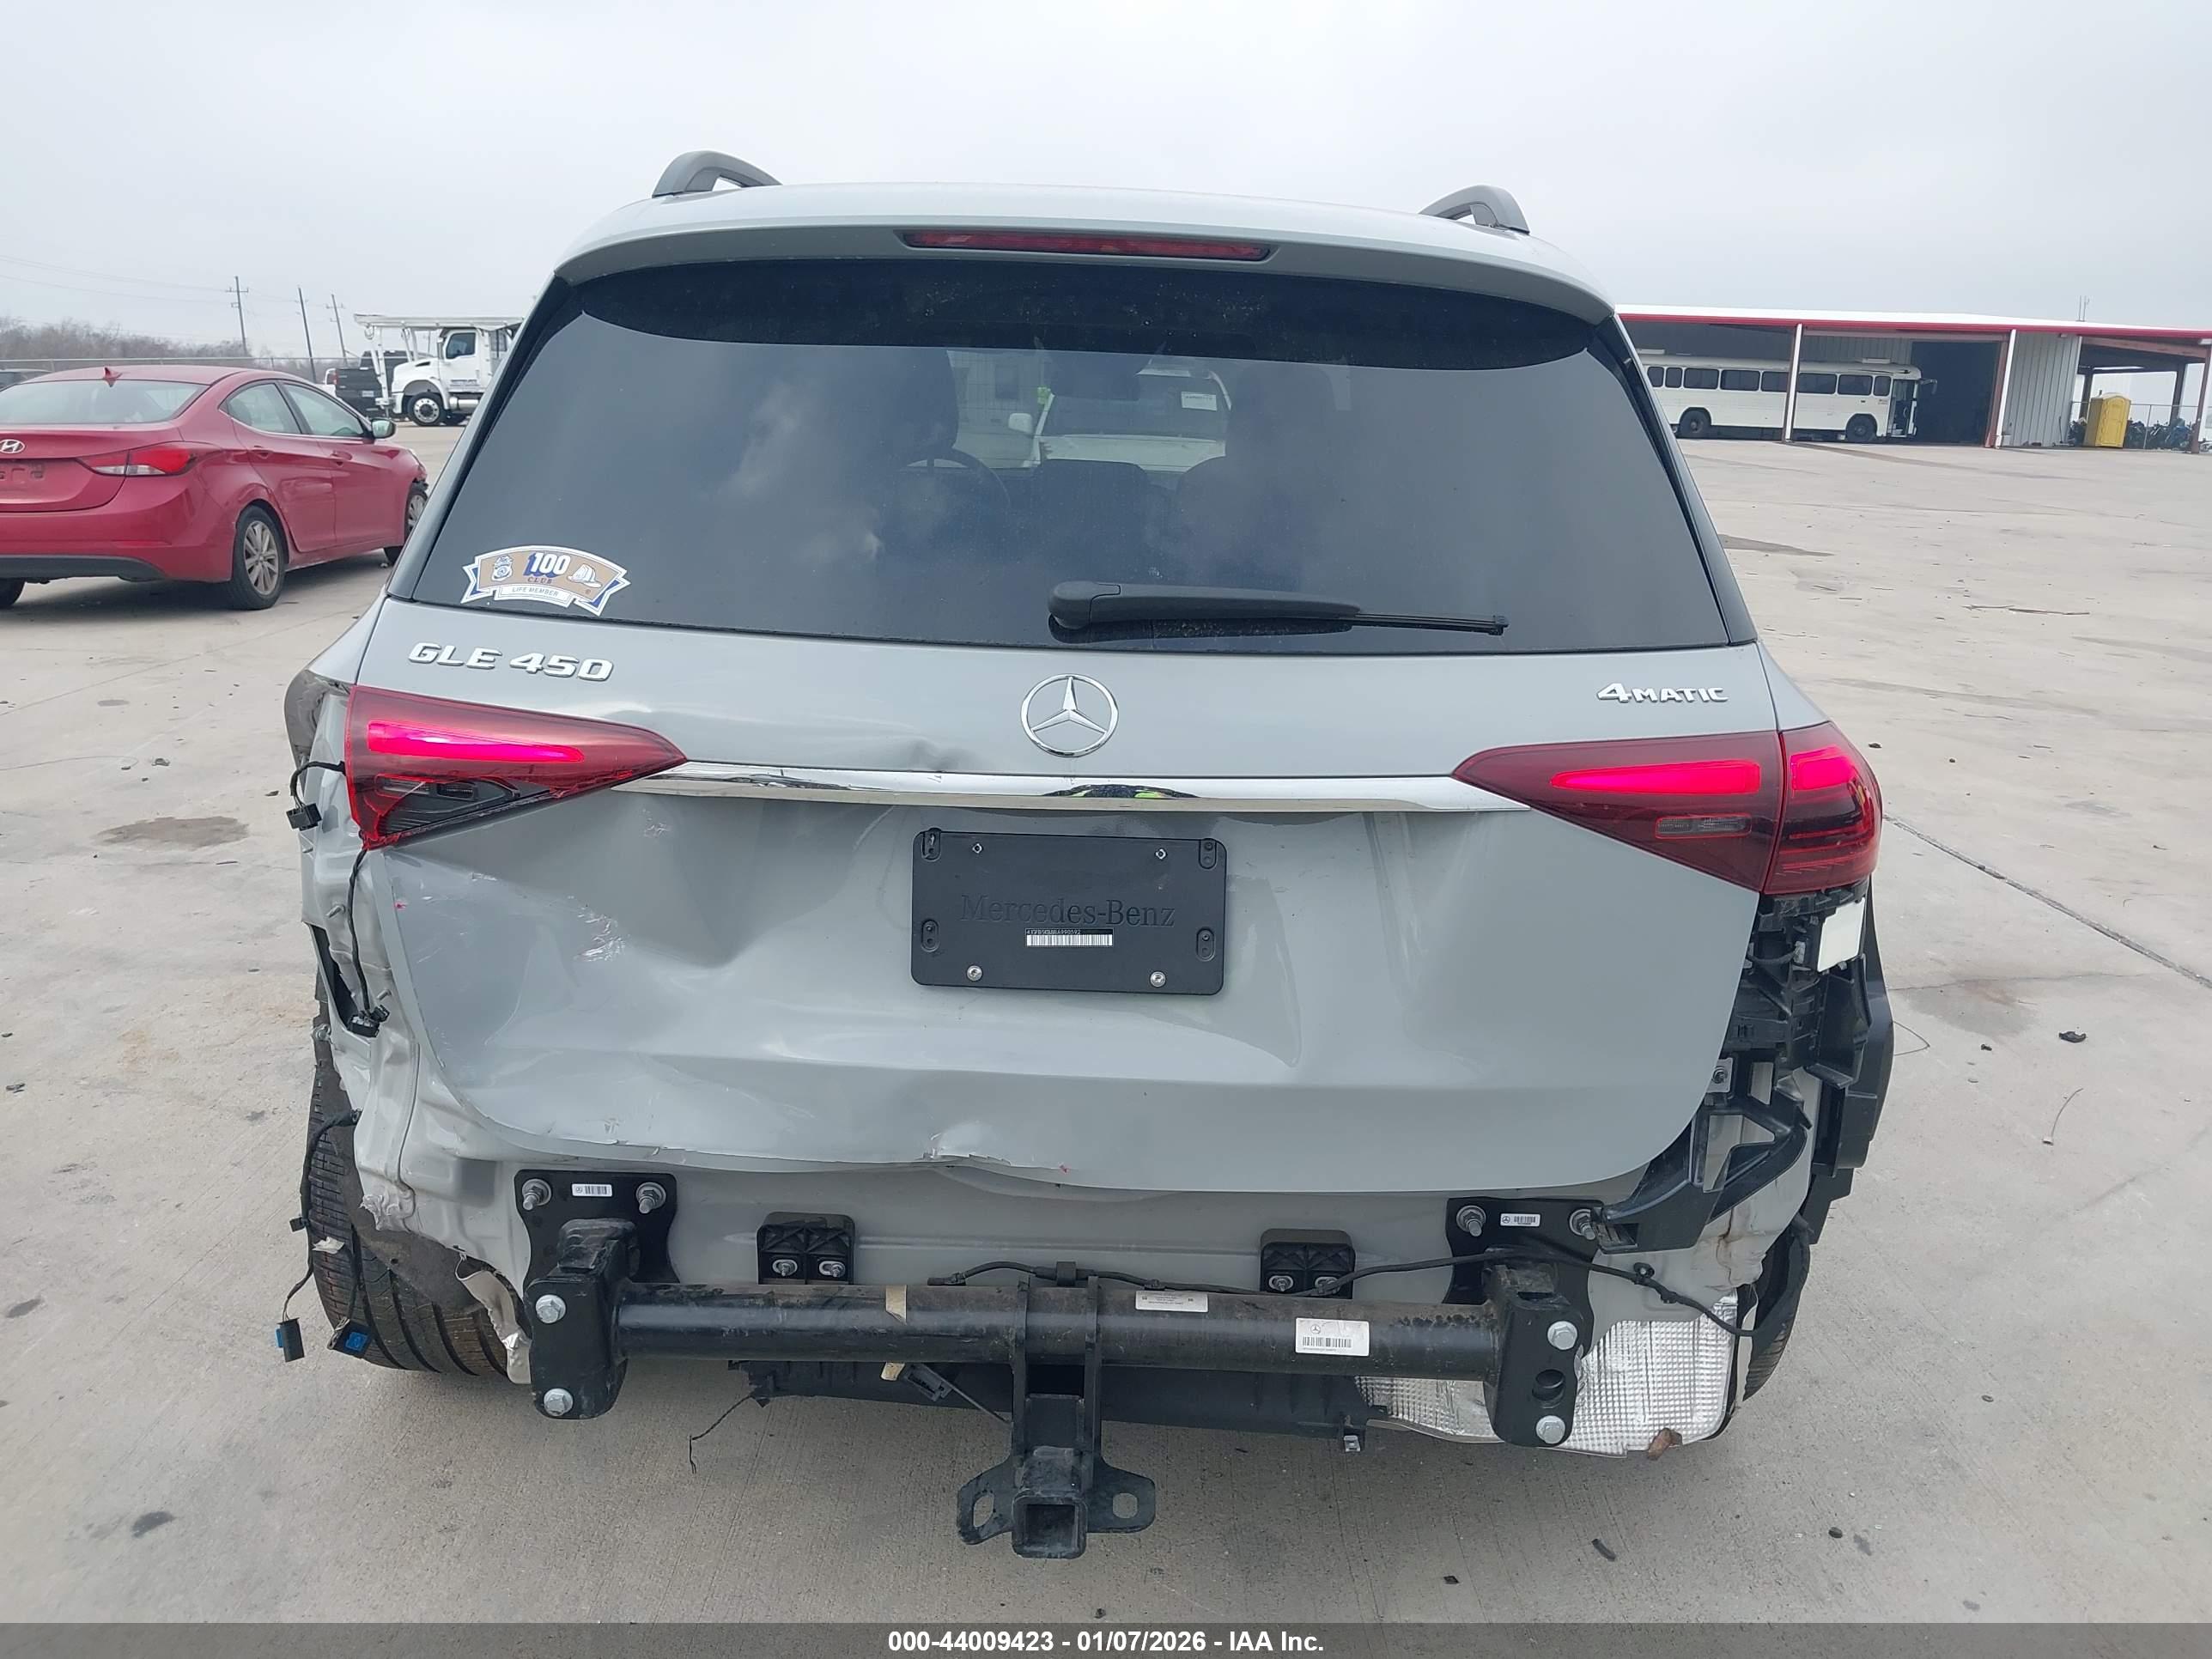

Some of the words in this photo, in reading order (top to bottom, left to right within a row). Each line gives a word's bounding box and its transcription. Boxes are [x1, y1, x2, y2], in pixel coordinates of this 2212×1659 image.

[523, 552, 571, 578] 100
[528, 587, 559, 597] MEMBER
[408, 642, 502, 670] GLE
[509, 653, 614, 682] 450
[1597, 683, 1729, 703] 4MATIC
[960, 895, 1176, 927] Mercedes-Benz
